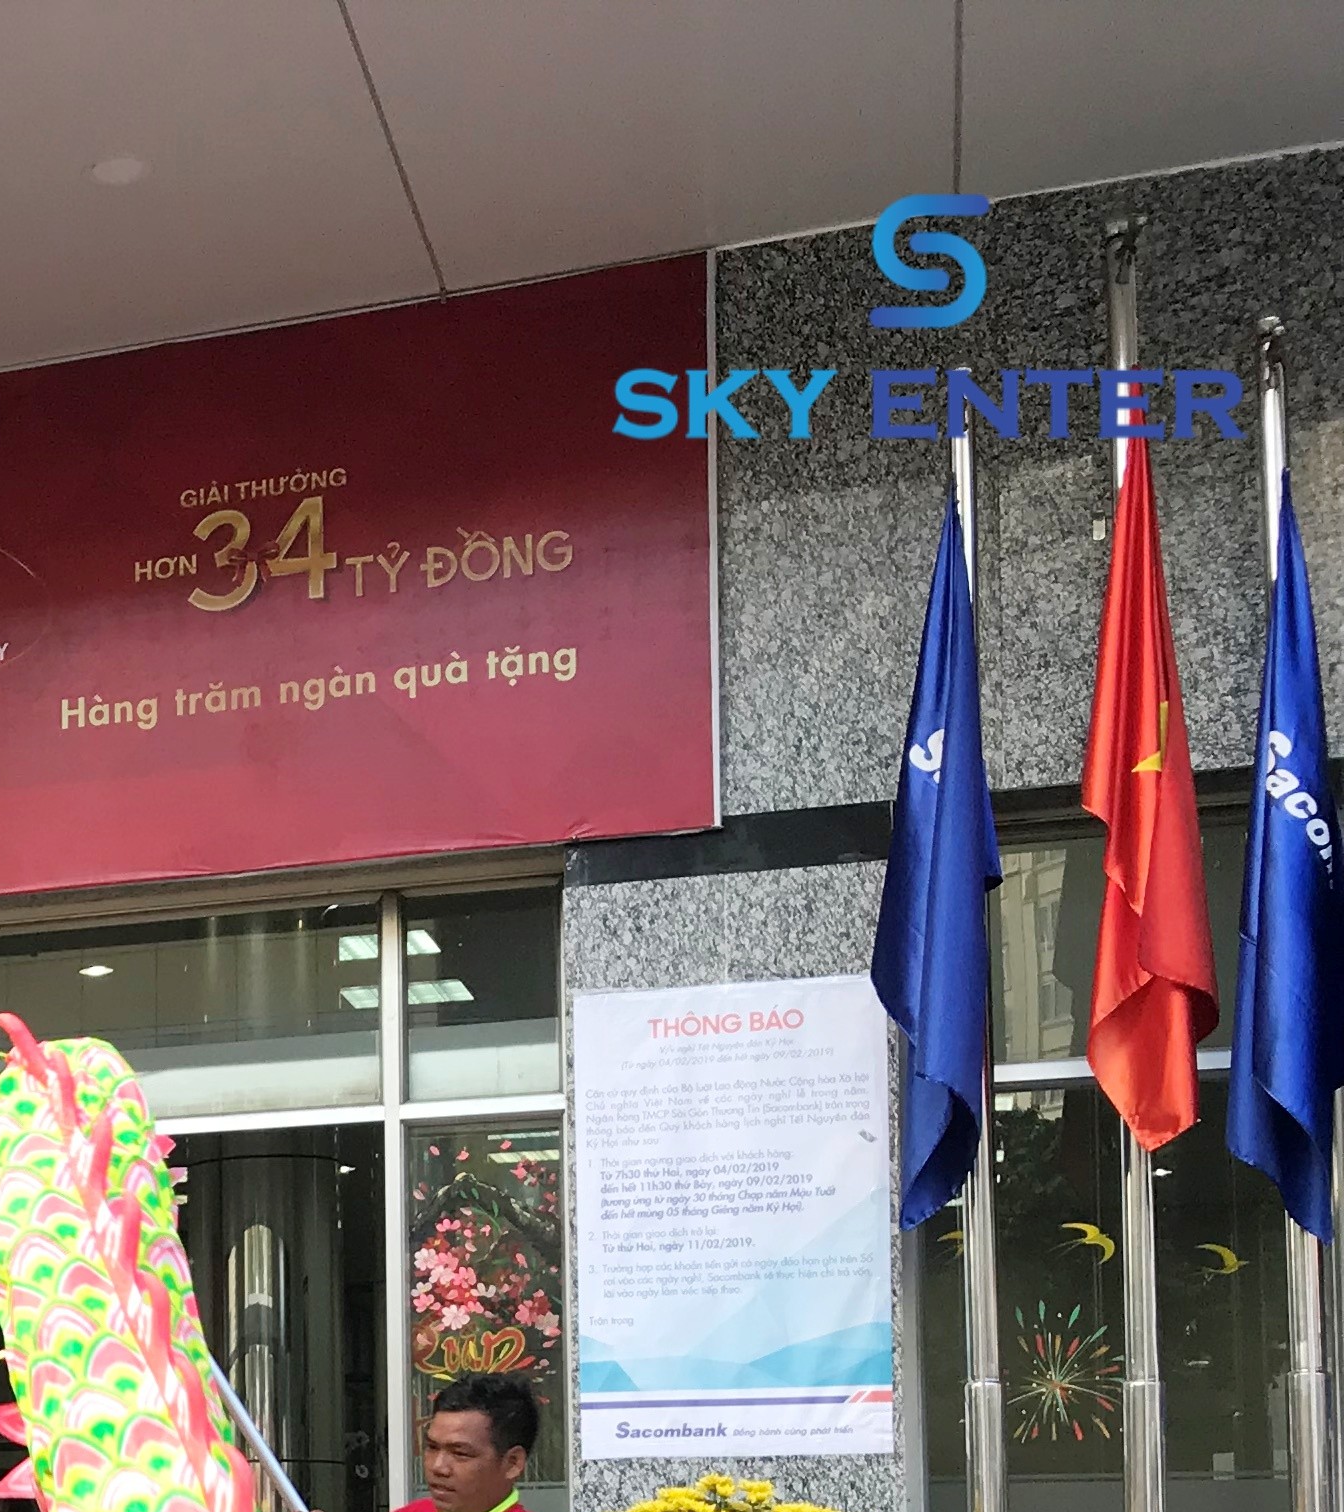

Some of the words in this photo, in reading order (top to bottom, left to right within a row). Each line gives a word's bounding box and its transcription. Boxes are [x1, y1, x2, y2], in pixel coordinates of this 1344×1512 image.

[180, 481, 229, 508] GIẢI
[235, 467, 347, 500] THƯỞNG
[134, 553, 198, 582] HƠN
[345, 541, 410, 597] TỶ
[420, 526, 572, 588] ĐỒNG
[61, 695, 158, 730] Hàng
[175, 681, 261, 716] trăm
[279, 665, 376, 710] ngàn
[393, 650, 469, 699] quà
[486, 646, 578, 687] tặng
[647, 1011, 742, 1039] THÔNG
[750, 1004, 804, 1032] BÁO
[614, 1169, 641, 1180] 7h30
[712, 1162, 779, 1176] 04/02/2019
[746, 1173, 813, 1187] 09/02/2019
[693, 1192, 706, 1203] 30
[666, 1207, 679, 1217] 05
[615, 1421, 727, 1438] Sacombank
